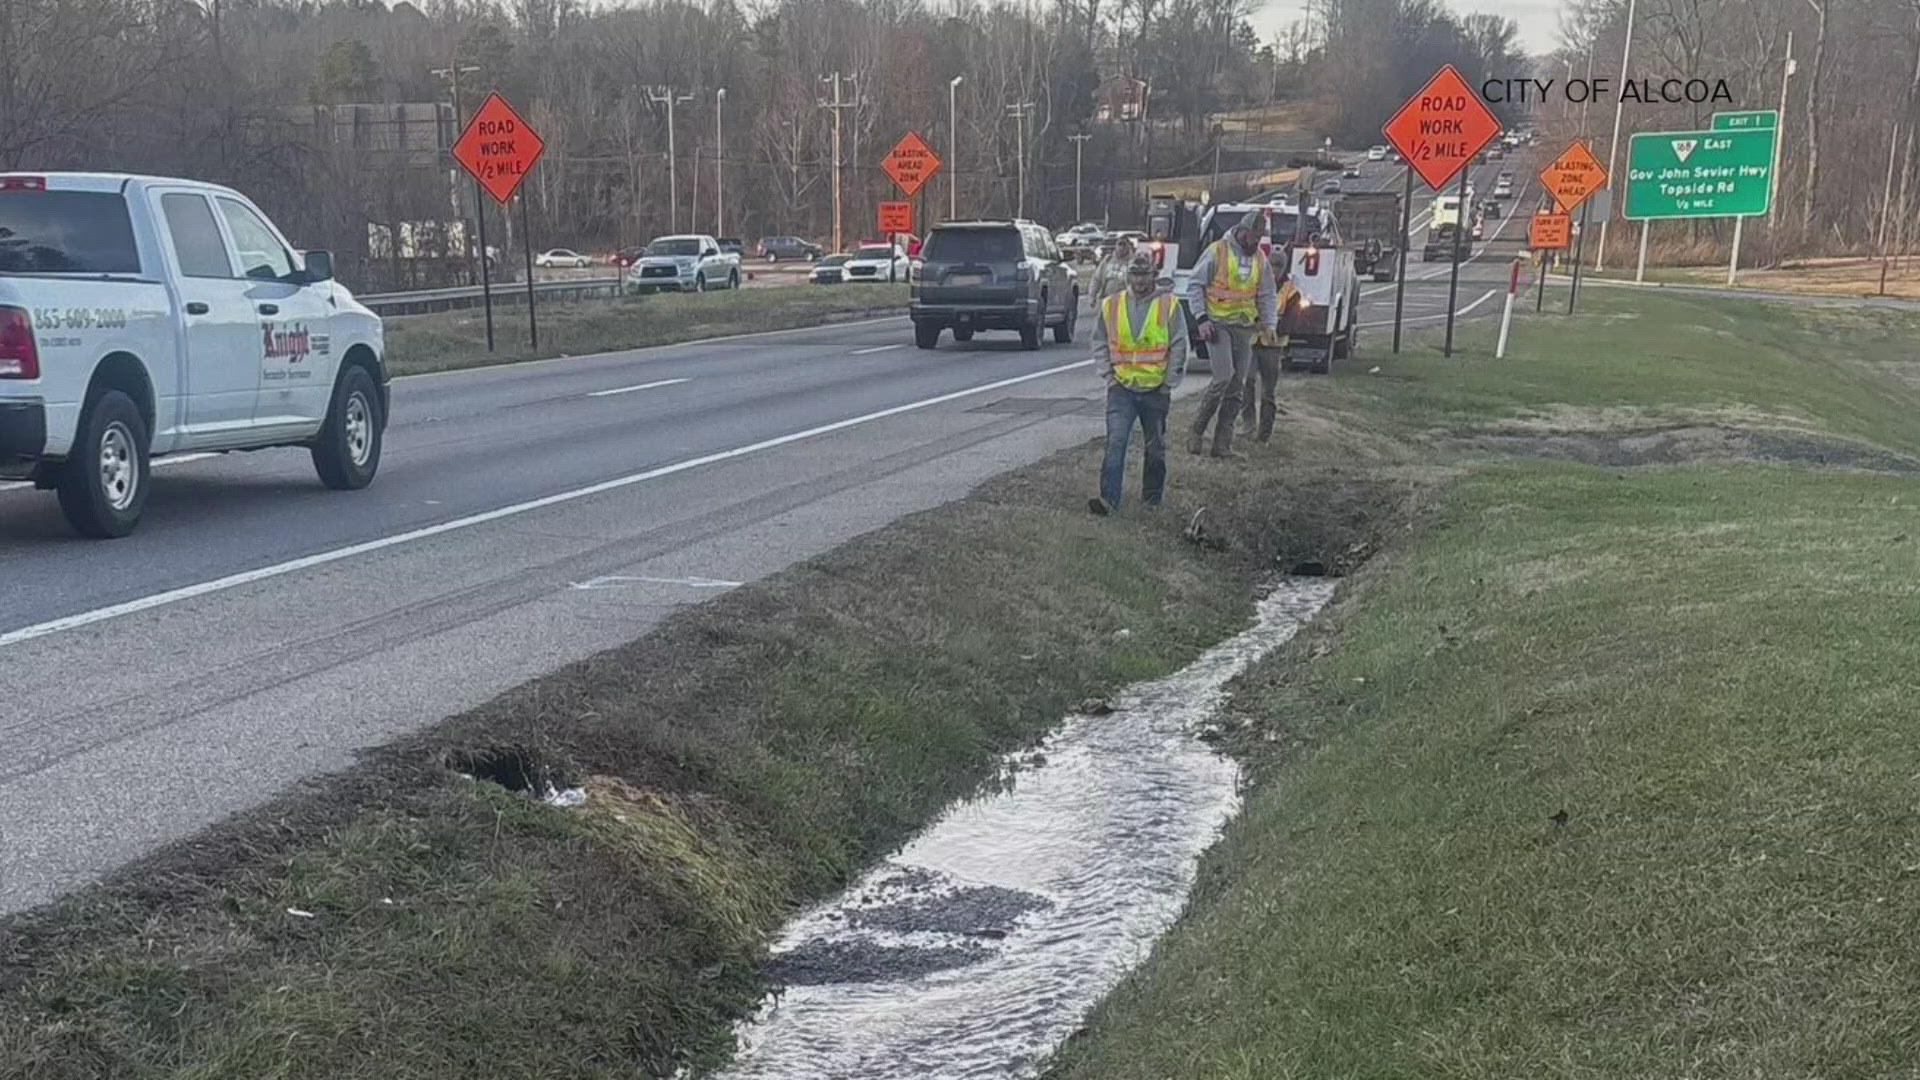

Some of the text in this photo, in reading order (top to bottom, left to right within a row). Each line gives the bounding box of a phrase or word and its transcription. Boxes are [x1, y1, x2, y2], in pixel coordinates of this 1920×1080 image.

[1420, 96, 1466, 112] ROAD
[478, 119, 514, 136] ROAD
[1419, 119, 1464, 135] WORK
[1729, 117, 1747, 126] EXIT
[480, 141, 516, 156] WORK
[1435, 142, 1468, 158] MILE
[1704, 138, 1732, 150] EAST
[893, 149, 929, 158] BLASTING
[496, 160, 522, 176] MILE
[897, 160, 922, 169] AHEAD
[1554, 161, 1594, 172] BLASTING
[899, 172, 919, 182] ZONE
[1561, 173, 1584, 183] ZONE
[1629, 165, 1768, 181] Gov John Sevier Hwy
[1557, 186, 1586, 196] AHEAD
[1660, 181, 1734, 197] Topside Rd
[1693, 199, 1714, 208] MILE
[261, 321, 310, 363] Knight
